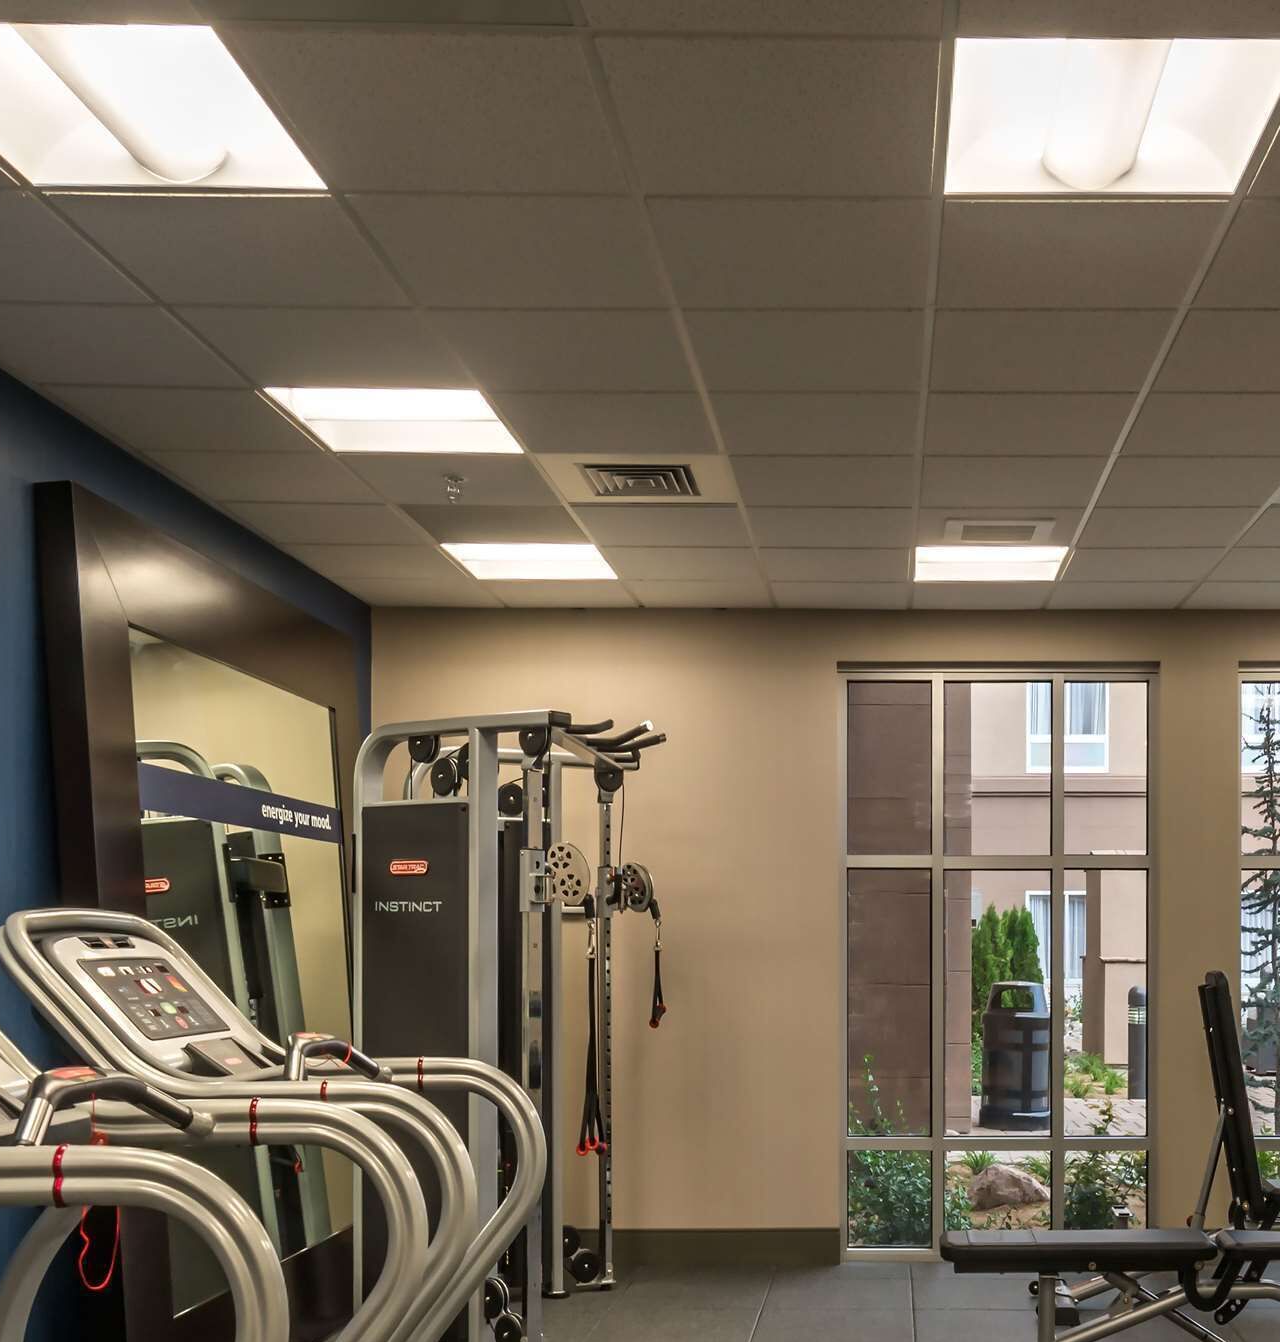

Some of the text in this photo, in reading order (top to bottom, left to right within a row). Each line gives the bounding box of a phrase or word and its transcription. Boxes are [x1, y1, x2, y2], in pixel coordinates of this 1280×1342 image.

[261, 804, 332, 831] energize your mood.
[408, 863, 425, 871] TRAC
[374, 901, 442, 913] INSTINCT
